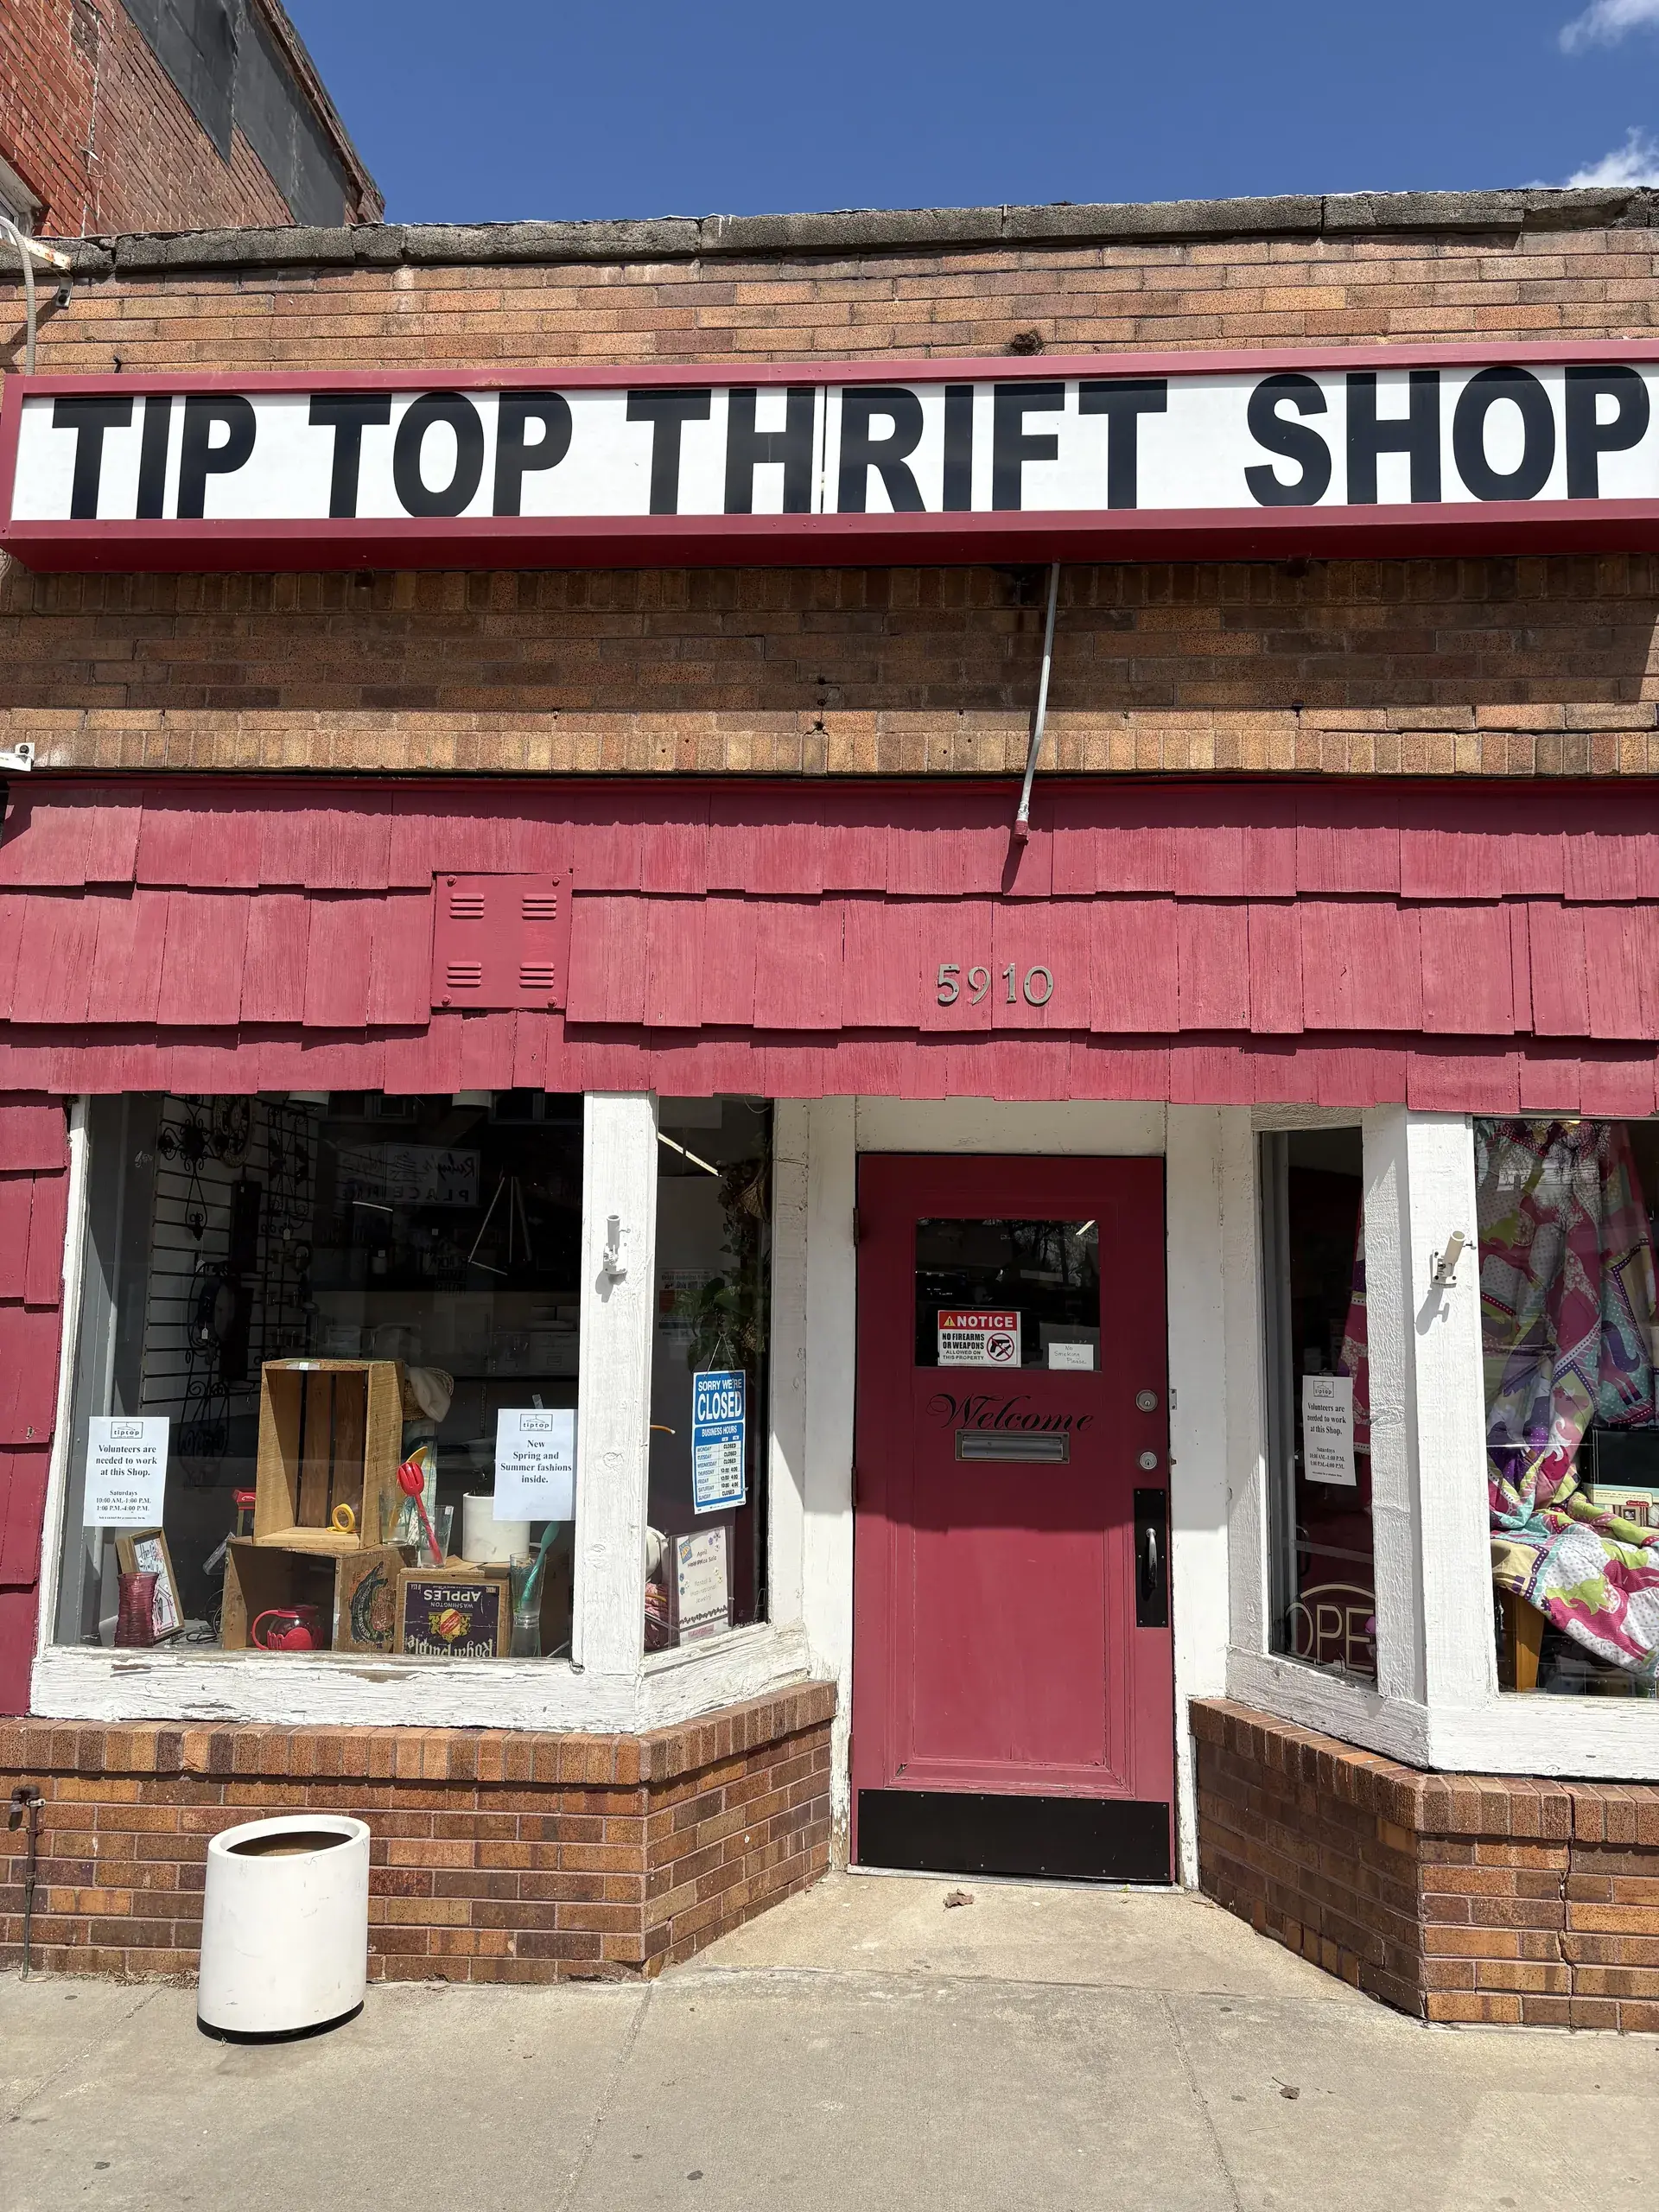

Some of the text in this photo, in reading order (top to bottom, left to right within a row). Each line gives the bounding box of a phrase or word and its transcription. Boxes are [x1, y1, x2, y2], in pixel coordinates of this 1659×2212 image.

[52, 365, 1651, 519] TIP TOP THRIFT SHOP
[938, 963, 1054, 1007] 5910
[957, 1315, 1014, 1328] NOTICE
[698, 1378, 742, 1392] SORRY WE'RE
[697, 1391, 742, 1421] CLOSED
[1307, 1402, 1333, 1412] Volunteers
[925, 1393, 1094, 1432] Welcome
[702, 1425, 737, 1437] BUSINESS HOURS
[1325, 1426, 1343, 1436] Shop.
[99, 1445, 141, 1453] Volunteers
[96, 1456, 124, 1465] needed
[136, 1456, 157, 1465] work
[512, 1452, 541, 1461] Spring
[500, 1463, 572, 1471] Summer fashions
[126, 1468, 150, 1478] Shop.
[521, 1475, 549, 1484] inside.
[423, 1590, 482, 1602] APPLES
